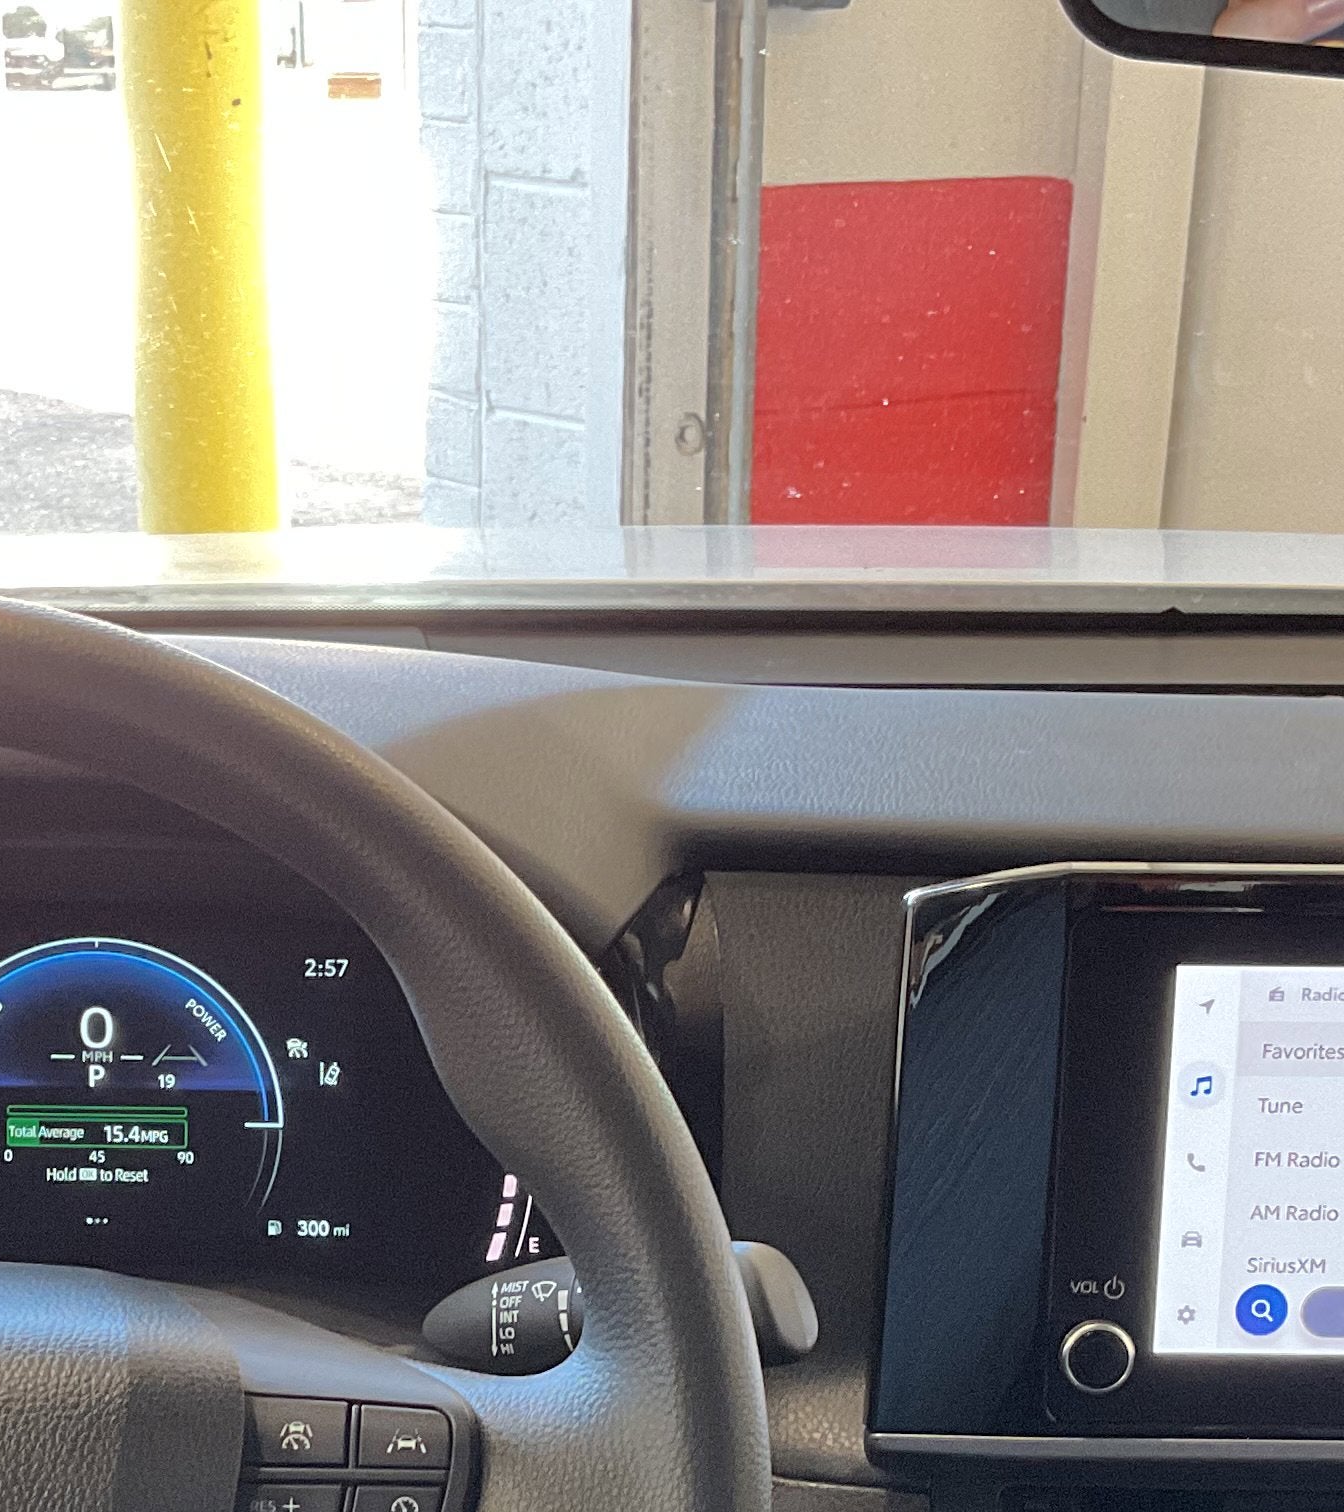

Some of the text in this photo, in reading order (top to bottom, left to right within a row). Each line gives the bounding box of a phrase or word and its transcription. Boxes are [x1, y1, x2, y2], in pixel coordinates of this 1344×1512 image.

[304, 958, 349, 977] 2:57
[79, 1006, 114, 1049] 0
[184, 997, 227, 1043] POWER
[81, 1050, 114, 1064] MPH
[87, 1065, 106, 1088] P
[157, 1074, 176, 1089] 19
[1258, 1097, 1304, 1114] Tune
[9, 1125, 37, 1138] Total
[38, 1126, 85, 1141] Average
[3, 1150, 13, 1162] 0
[88, 1150, 106, 1163] 45
[176, 1151, 195, 1164] 90
[1254, 1152, 1340, 1168] FM Radio
[47, 1168, 77, 1181] Hold
[100, 1168, 113, 1181] to
[114, 1168, 149, 1182] Reset
[1250, 1204, 1340, 1221] AM Radio
[297, 1220, 350, 1237] 300 mi
[528, 1236, 540, 1253] E
[1246, 1257, 1327, 1274] SiriusXM
[500, 1280, 529, 1292] MIST
[1070, 1280, 1099, 1294] VOL
[499, 1296, 522, 1308] OFF
[499, 1310, 520, 1323] INT
[499, 1327, 515, 1340] LO
[499, 1343, 515, 1356] HI
